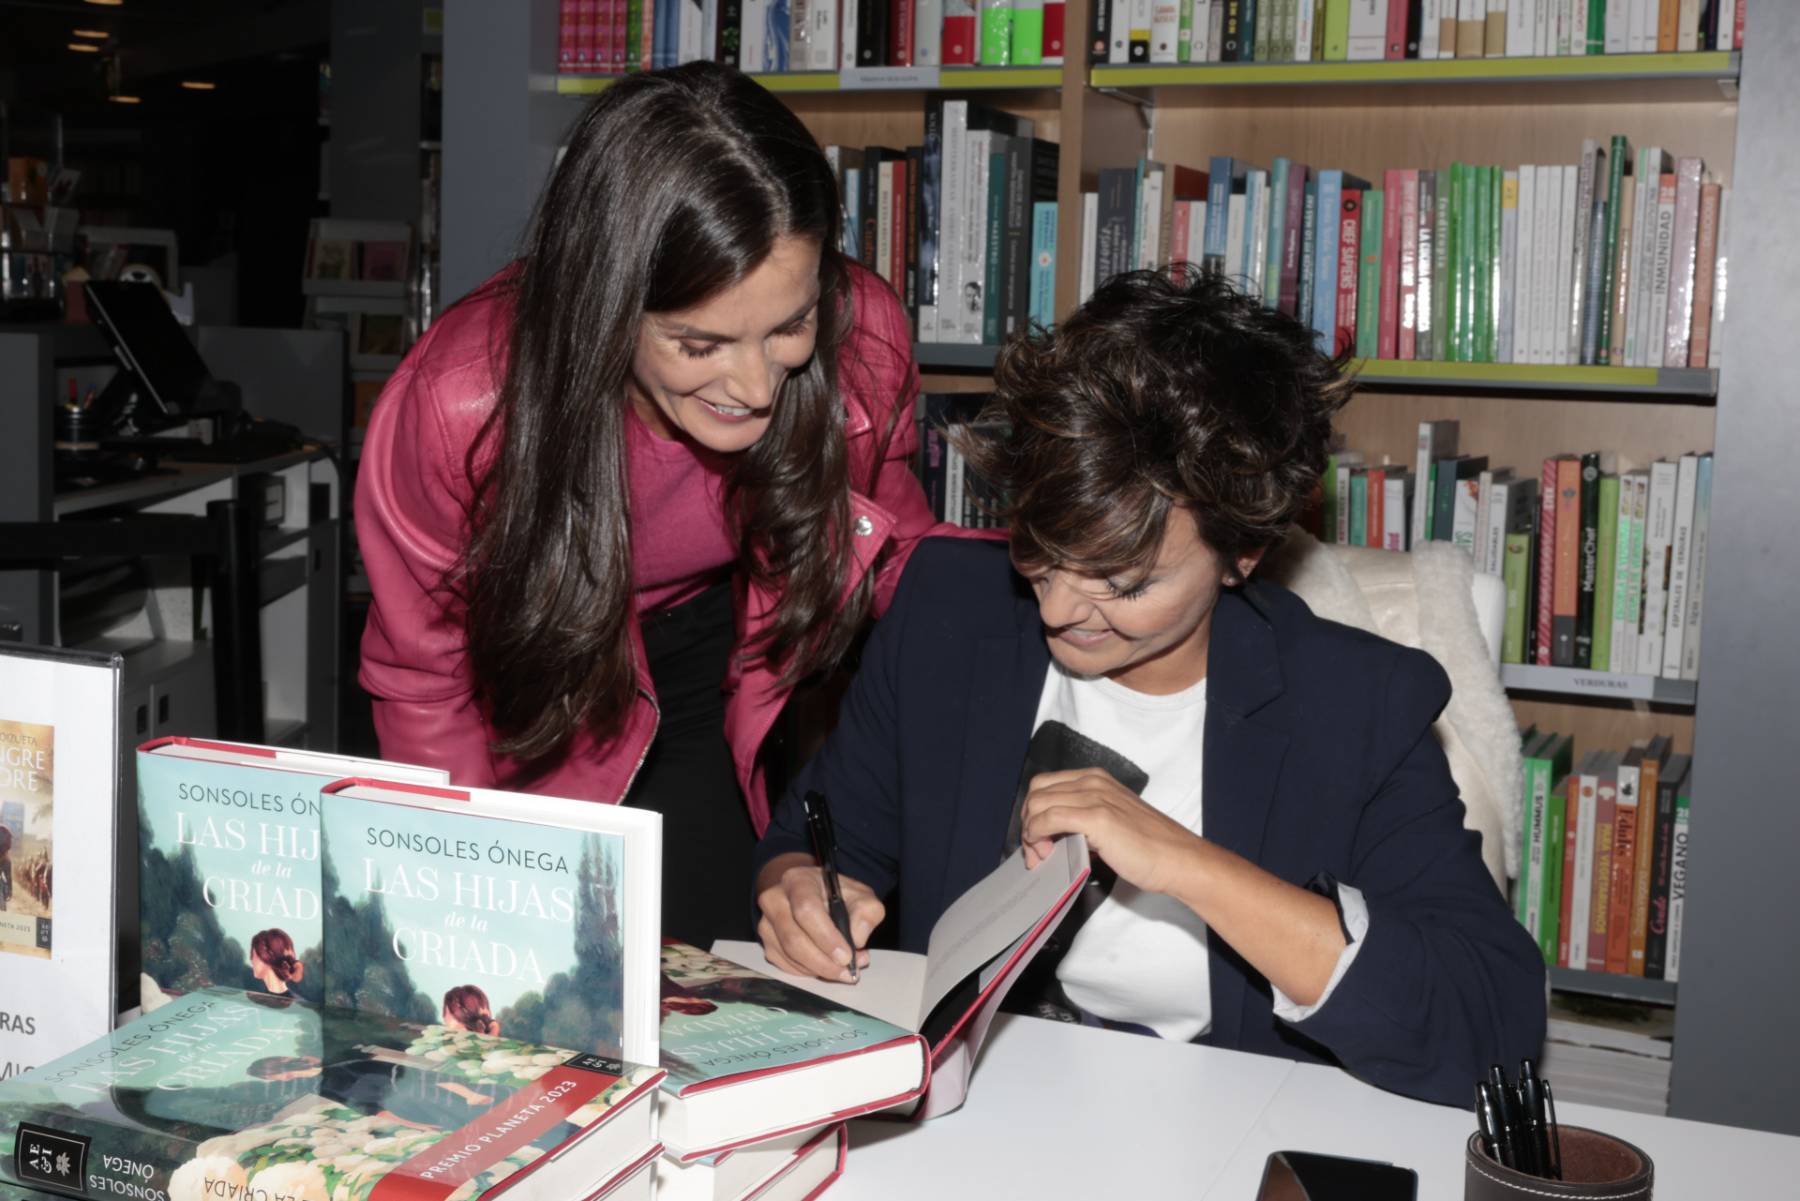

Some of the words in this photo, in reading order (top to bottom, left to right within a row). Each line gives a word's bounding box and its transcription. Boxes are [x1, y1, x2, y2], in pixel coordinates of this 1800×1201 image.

[1342, 220, 1356, 243] CHEF
[1341, 247, 1356, 288] SAPIENS
[1655, 211, 1671, 294] INMUNIDAD
[1583, 527, 1596, 592] MasterChef
[1678, 526, 1688, 565] VERDURAS
[1676, 571, 1684, 580] DE
[1672, 584, 1682, 628] ESPIRALES
[1574, 678, 1628, 689] VERDURAS
[178, 783, 284, 812] SONSOLES
[176, 812, 246, 851] LAS
[258, 822, 320, 862] HIJ
[1533, 795, 1544, 843] HUMMUS
[252, 860, 271, 876] de
[276, 864, 292, 880] la
[367, 827, 480, 861] SONSOLES
[488, 840, 568, 874] ÓNEGA
[1673, 832, 1688, 901] VEGANO
[203, 876, 320, 920] CRIAD
[363, 857, 439, 902] LAS
[454, 872, 574, 922] HIJAS
[445, 912, 466, 928] de
[472, 916, 488, 933] la
[393, 928, 546, 984] CRIADA
[0, 1011, 36, 1036] RAS
[662, 1006, 788, 1037] CRIADA
[779, 1017, 852, 1038] LAS
[44, 1033, 152, 1084] SONSOLES
[150, 1000, 216, 1033] ÓNEGA
[67, 1056, 156, 1094] LAS
[148, 1004, 258, 1054] HIJAS
[156, 1028, 304, 1091] CRIADA
[670, 1032, 780, 1058] HIJAS
[702, 1046, 772, 1067] ÓNEGA
[772, 1029, 868, 1054] SONSOLES
[420, 1143, 482, 1180] PREMIO
[479, 1102, 544, 1144] PLANETA
[546, 1080, 577, 1110] 2023
[90, 1174, 164, 1201] SONSOLES
[103, 1154, 154, 1183] ÓNEGA
[204, 1176, 268, 1201] CRIADA
